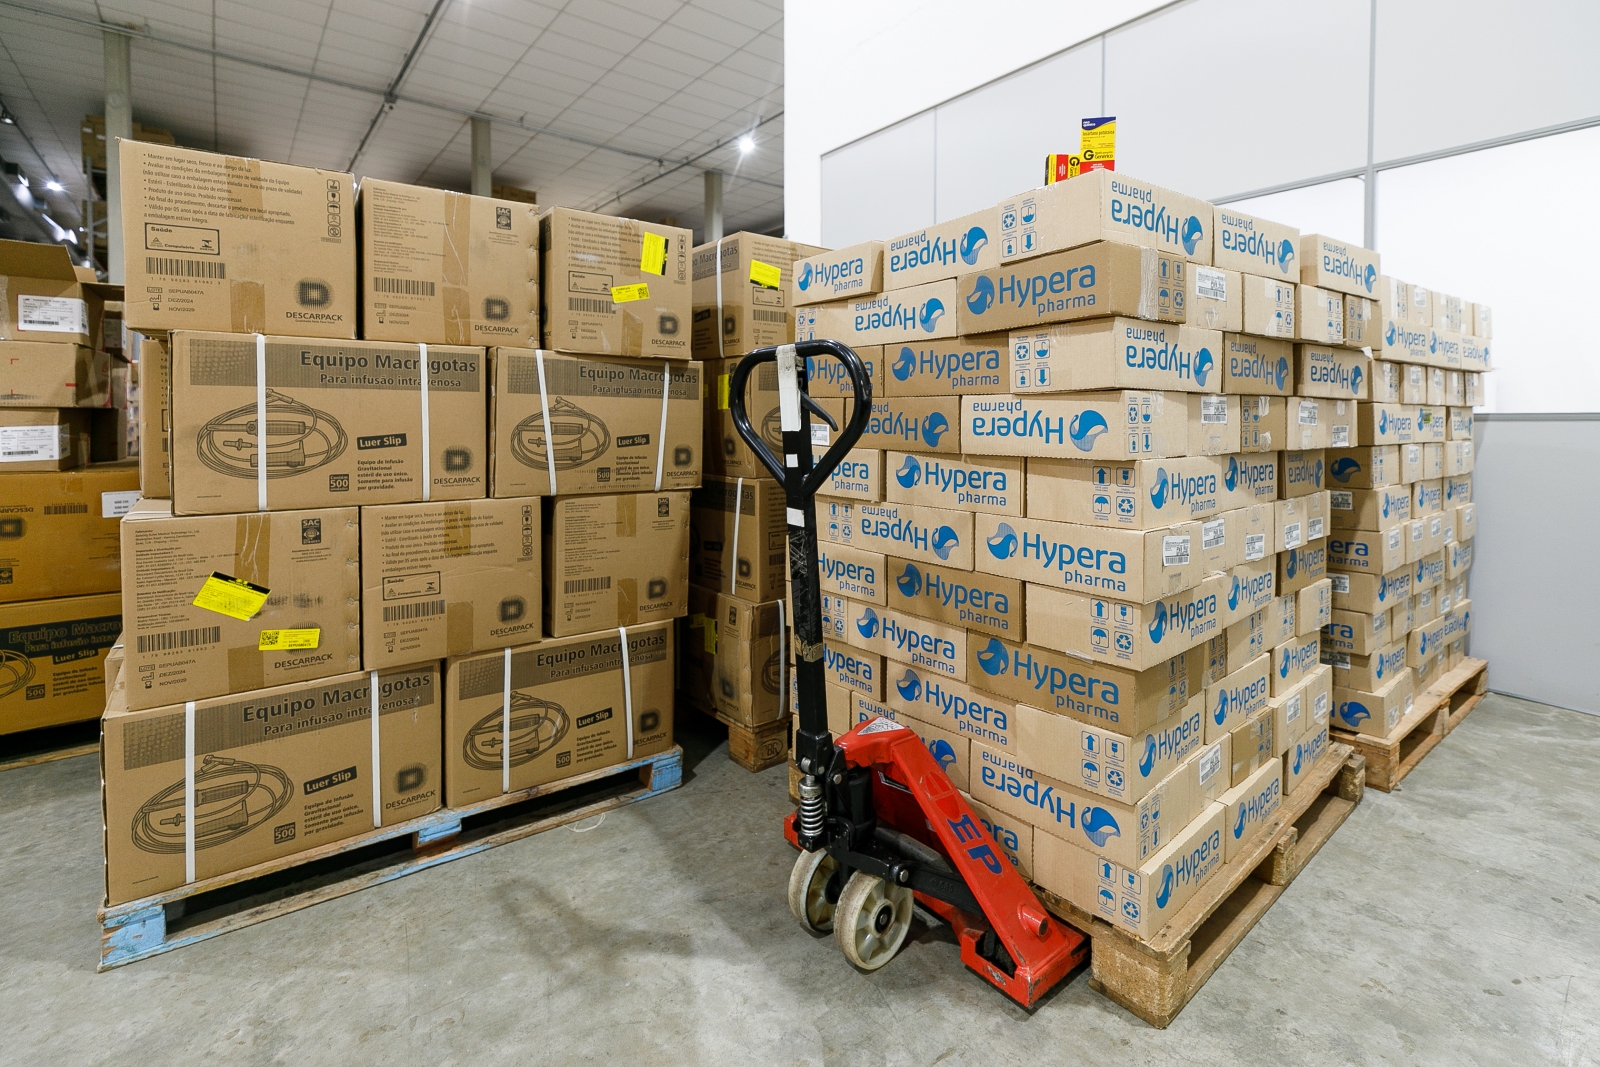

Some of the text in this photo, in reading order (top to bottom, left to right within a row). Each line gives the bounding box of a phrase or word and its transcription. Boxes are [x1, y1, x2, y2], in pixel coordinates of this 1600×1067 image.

[1084, 150, 1094, 160] G
[1111, 180, 1152, 203] pharma
[1111, 199, 1179, 245] Hypera
[891, 232, 926, 250] pharma
[891, 236, 956, 272] Hypera
[1222, 229, 1276, 266] Hypera
[815, 257, 863, 287] Hypera
[1324, 255, 1363, 285] Hypera
[999, 264, 1096, 308] Hypera
[286, 311, 343, 321] DESCARPACK
[855, 303, 916, 332] Hypera
[1037, 292, 1096, 317] pharma
[474, 324, 519, 333] DESCARPACK
[1126, 327, 1165, 343] pharma
[1398, 327, 1426, 347] Hypera
[1438, 335, 1459, 354] Hypera
[301, 351, 476, 374] Equipo Macrgotas
[920, 349, 1000, 380] Hypera
[1126, 341, 1190, 380] Hypera
[1230, 352, 1274, 385] Hypera
[320, 374, 394, 385] Para infusão
[580, 366, 624, 382] Equipo
[952, 374, 1000, 390] pharma
[1310, 361, 1349, 390] Hypera
[593, 385, 641, 394] Para infusão
[973, 399, 1022, 412] pharma
[635, 436, 646, 444] Slip
[972, 410, 1064, 445] Hypera
[360, 437, 402, 447] Luer Slip
[925, 462, 1007, 493] Hypera
[1239, 461, 1274, 490] Hypera
[958, 491, 1007, 507] pharma
[1171, 472, 1216, 506] Hypera
[861, 505, 898, 519] pharma
[861, 517, 928, 551] Hypera
[1023, 533, 1126, 575] Hypera
[1298, 546, 1324, 572] Hypera
[839, 580, 875, 597] pharma
[925, 572, 1009, 614] Hypera
[1064, 569, 1126, 592] pharma
[1241, 571, 1272, 604] Hypera
[640, 601, 673, 612] DESCARPACK
[959, 608, 1009, 630] pharma
[1170, 594, 1216, 631] Hypera
[9, 628, 67, 644] Equipo
[490, 623, 534, 636] DESCARPACK
[882, 617, 956, 659] Hypera
[78, 649, 95, 657] Slip
[275, 653, 333, 668] DESCARPACK
[537, 635, 665, 667] Equipo Macrgotas
[823, 644, 873, 680] ypera
[912, 652, 955, 675] pharma
[1291, 639, 1318, 666] Hypera
[550, 663, 604, 678] Para infusão
[1013, 650, 1119, 705] Hypera
[243, 674, 430, 722] Equipo Macrgotas
[925, 680, 1007, 731] Hypera
[1230, 675, 1265, 711] Hypera
[578, 712, 609, 726] Luer Slip
[858, 699, 896, 720] pharma
[1056, 694, 1119, 723] pharma
[264, 712, 342, 735] Para infusão
[959, 718, 1008, 746] pharma
[1158, 712, 1200, 760] Hypera
[1303, 728, 1327, 757] Hypera
[557, 755, 570, 764] 500
[982, 750, 1033, 780] pharma
[306, 770, 351, 792] Luer Slip
[386, 790, 435, 809] DESCARPACK
[982, 766, 1076, 829] Hypera
[1247, 778, 1279, 823] Hypera
[275, 828, 294, 840] 500
[1176, 830, 1220, 884] Hypera
